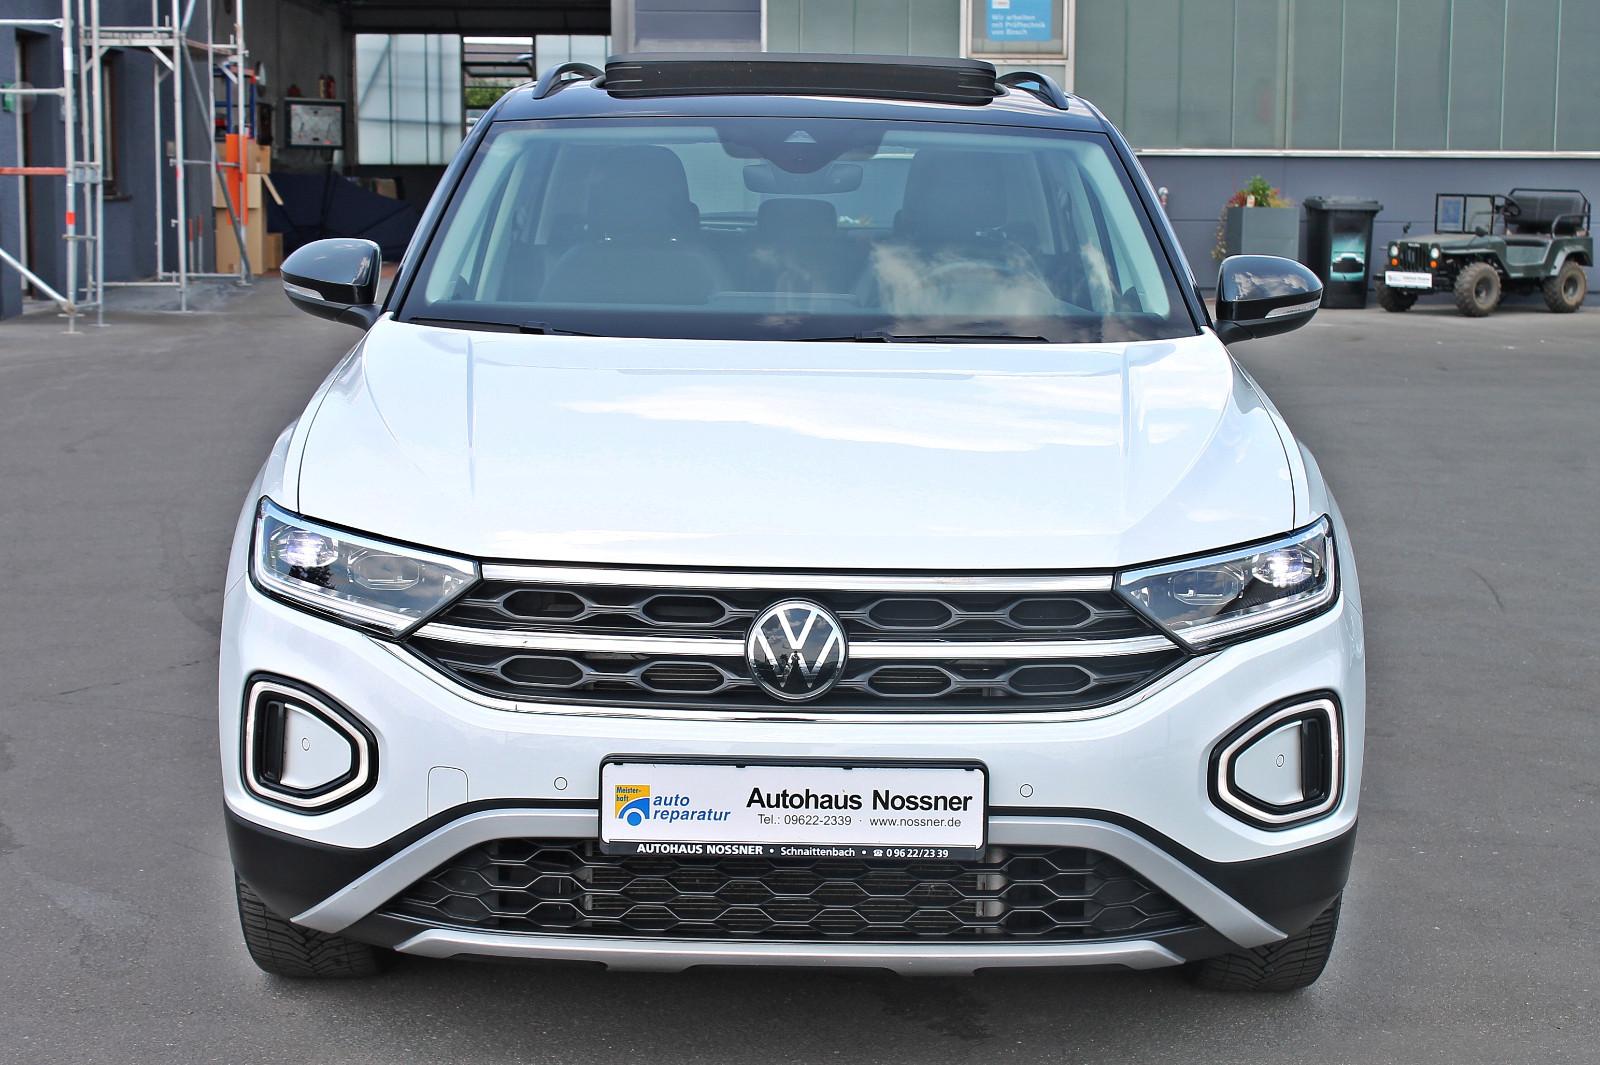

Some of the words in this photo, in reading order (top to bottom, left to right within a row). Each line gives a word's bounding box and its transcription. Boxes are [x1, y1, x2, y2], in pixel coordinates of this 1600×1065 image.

[616, 786, 641, 794] Meister-
[653, 794, 690, 807] auto
[746, 787, 863, 811] Autohaus
[872, 789, 973, 812] Nossner
[653, 808, 731, 823] reparatur
[757, 813, 780, 825] Tel.:
[784, 814, 852, 826] 09622-2339
[869, 817, 961, 828] www.nossner.de
[636, 843, 704, 854] AUTOHAUS
[706, 844, 764, 855] NOSSNER
[780, 846, 856, 857] Schnaittenbach
